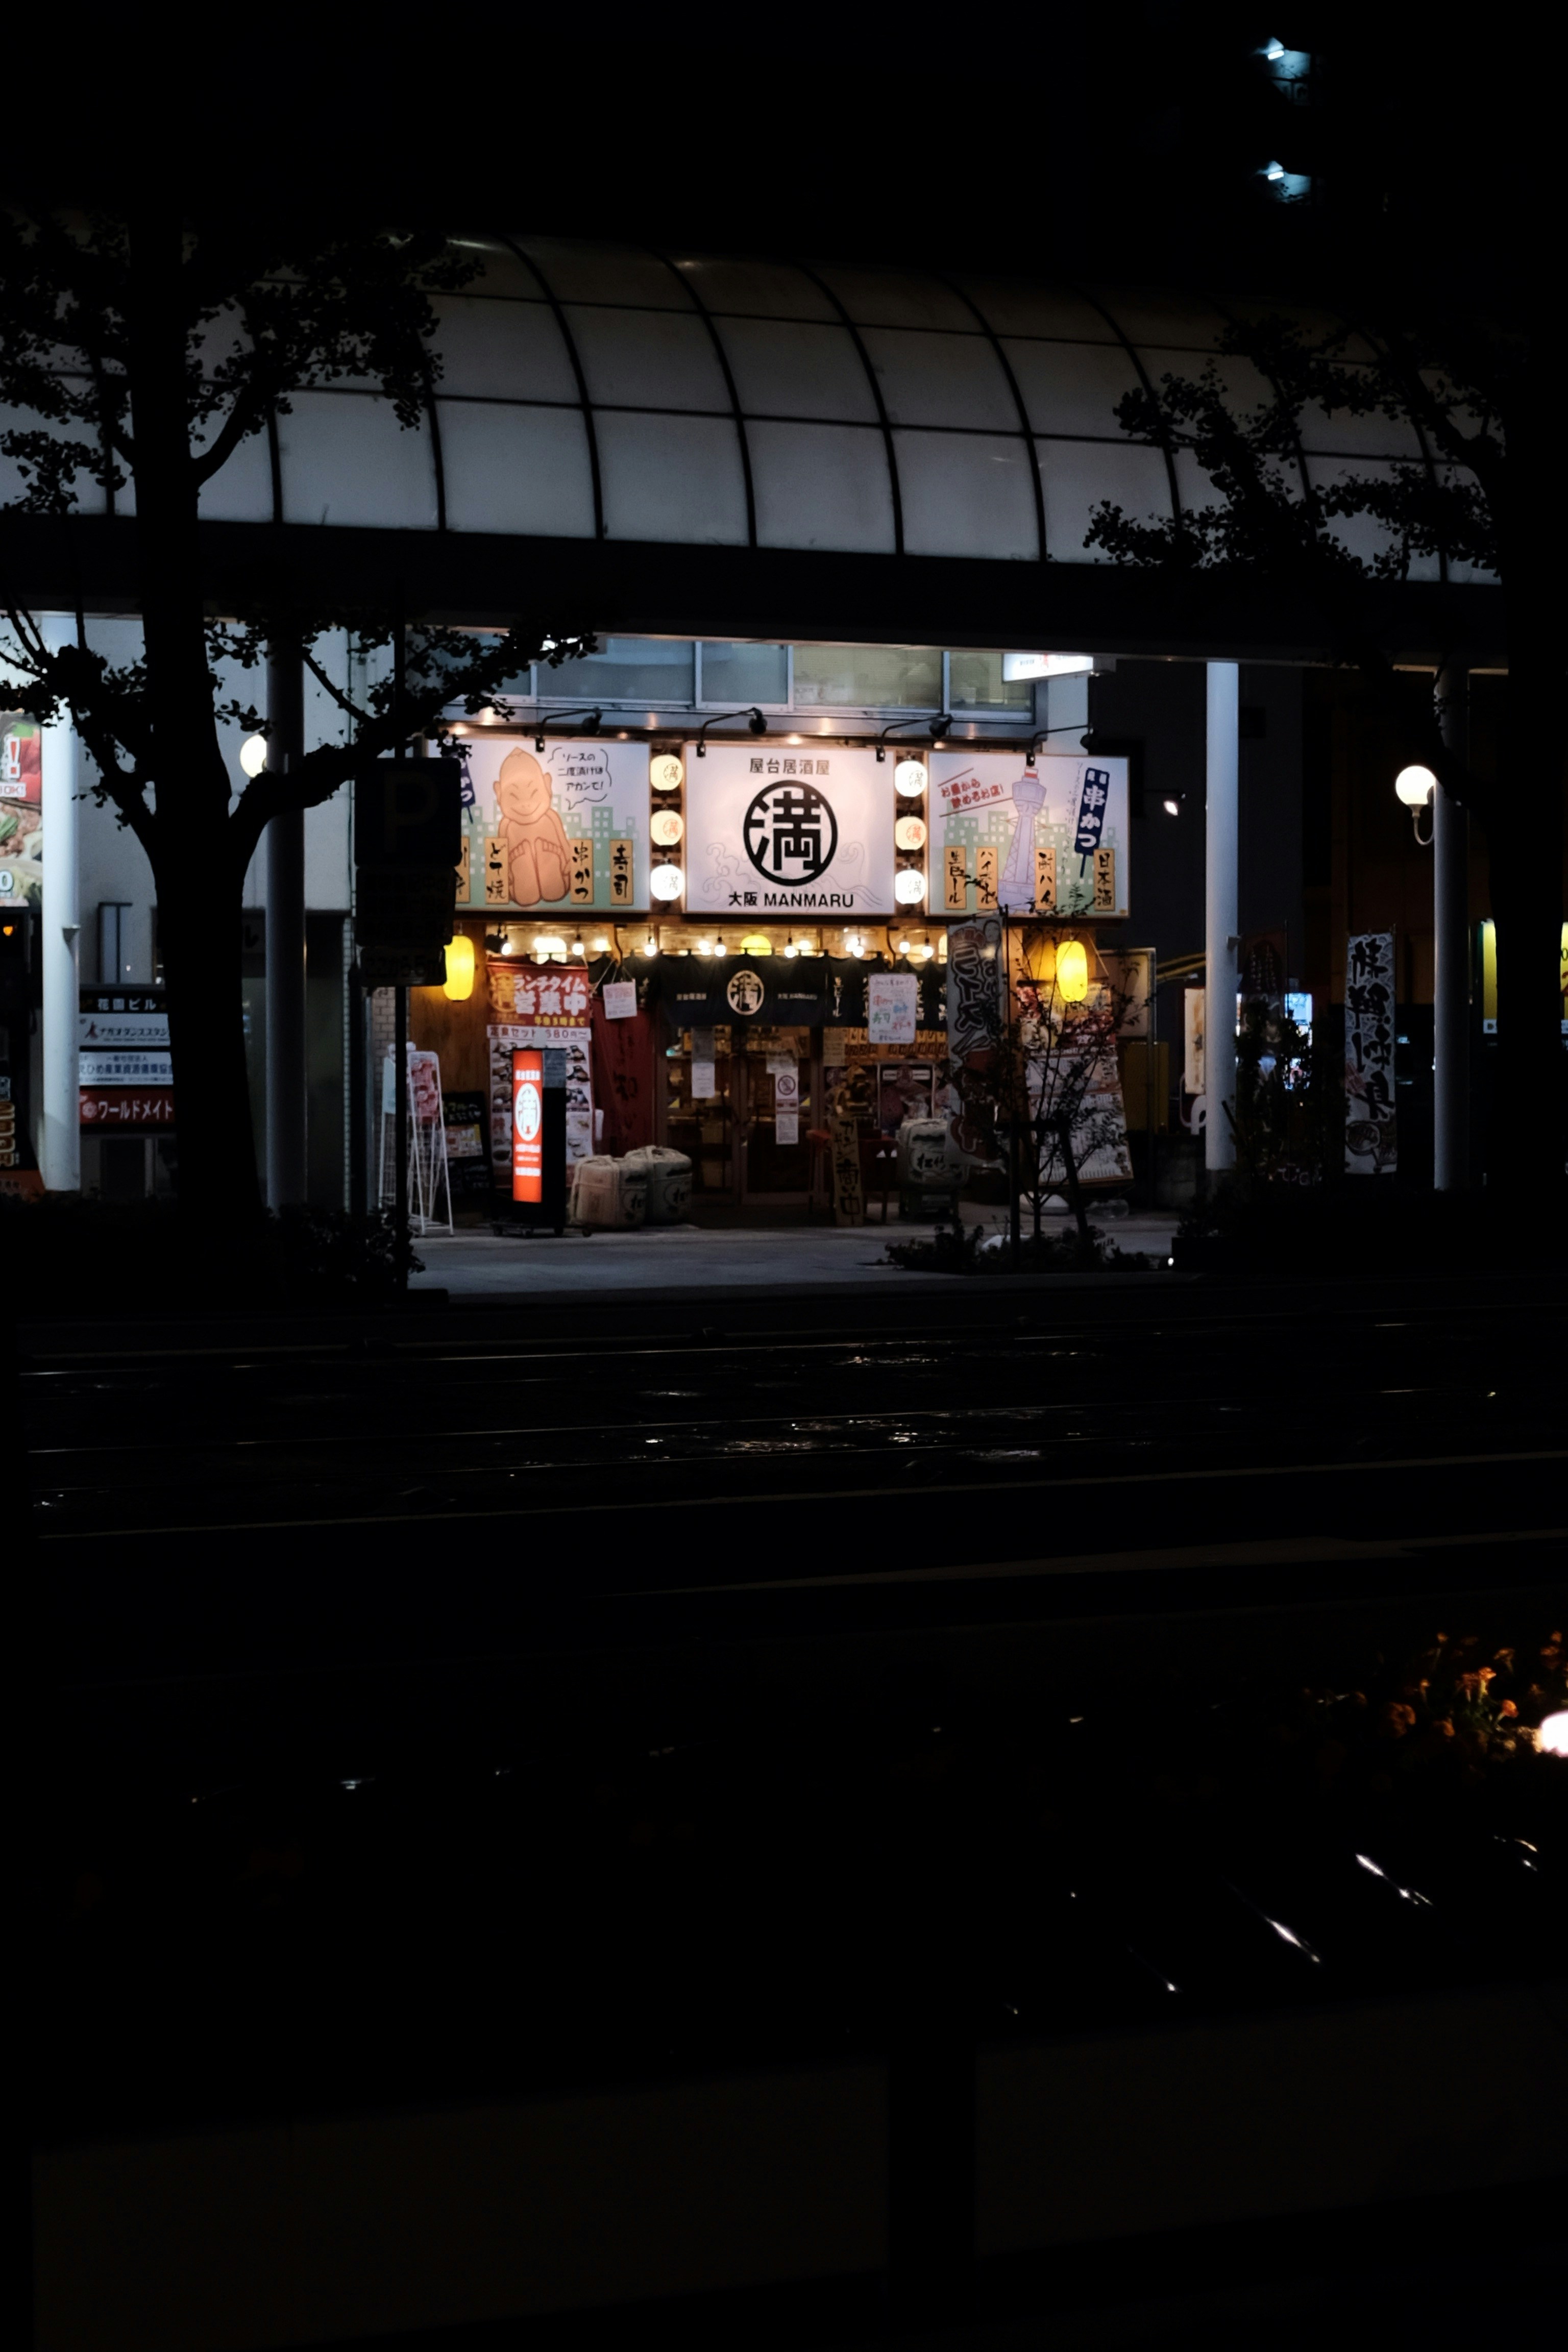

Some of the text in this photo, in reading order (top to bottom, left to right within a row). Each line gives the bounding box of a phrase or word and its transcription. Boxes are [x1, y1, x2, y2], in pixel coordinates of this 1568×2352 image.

[562, 752, 596, 762] ソースの
[750, 758, 830, 775] 屋台居酒屋
[383, 770, 440, 853] P
[743, 779, 838, 887] 満
[1077, 783, 1106, 848] 串かつ
[486, 843, 506, 899] どて焼
[572, 841, 591, 899] 串かつ
[613, 844, 630, 898] 寿司
[1097, 852, 1113, 906] 日本酒
[728, 892, 854, 908] 大阪 MANMARU
[513, 974, 586, 993] ランチタイム
[514, 990, 586, 1016] 営業中
[97, 1099, 173, 1120] ワールドメイト
